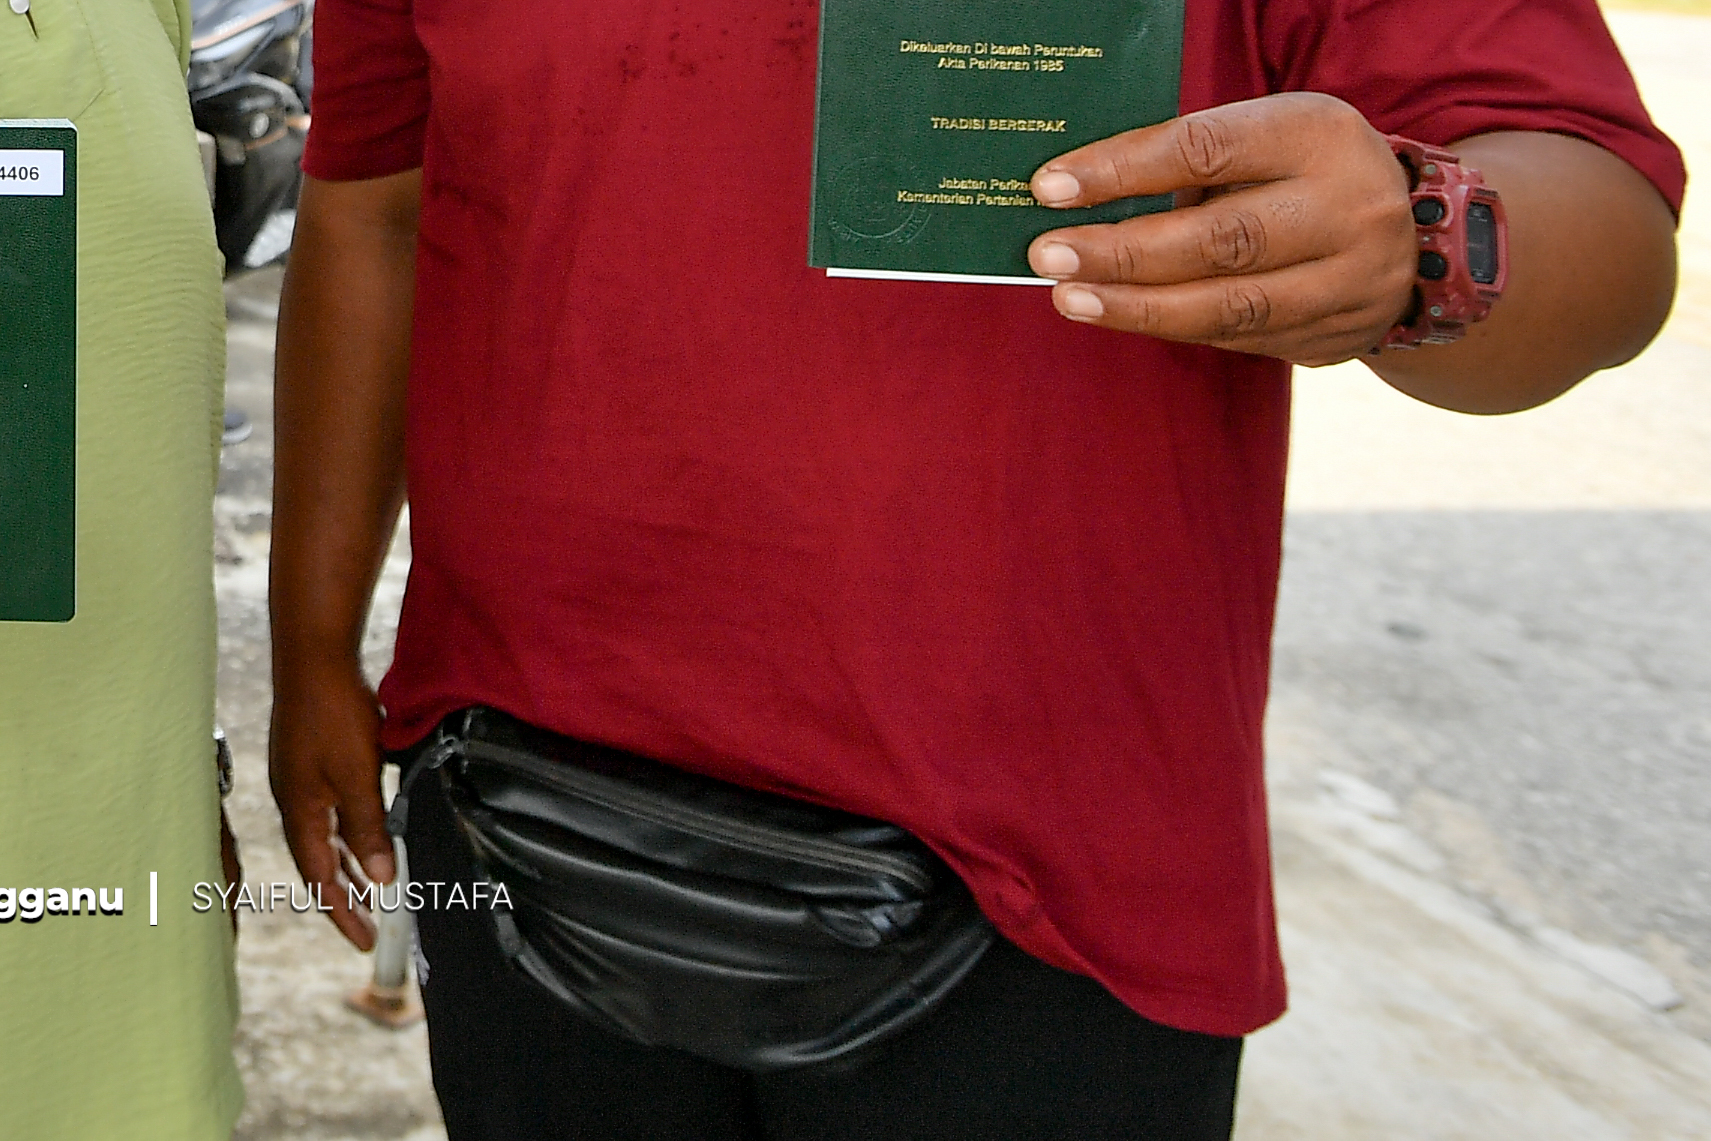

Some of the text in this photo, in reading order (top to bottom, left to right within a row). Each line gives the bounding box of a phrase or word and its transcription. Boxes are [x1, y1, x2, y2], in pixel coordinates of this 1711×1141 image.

[900, 40, 1103, 58] Dikeluarkan Di bawah Peruntukan
[938, 57, 1065, 72] Akta Perikanan 1985
[930, 117, 1067, 132] TRADISI BERGERAK
[938, 177, 987, 190] Jabatan
[897, 190, 974, 205] Kementerian
[976, 193, 1035, 206] Pertanian
